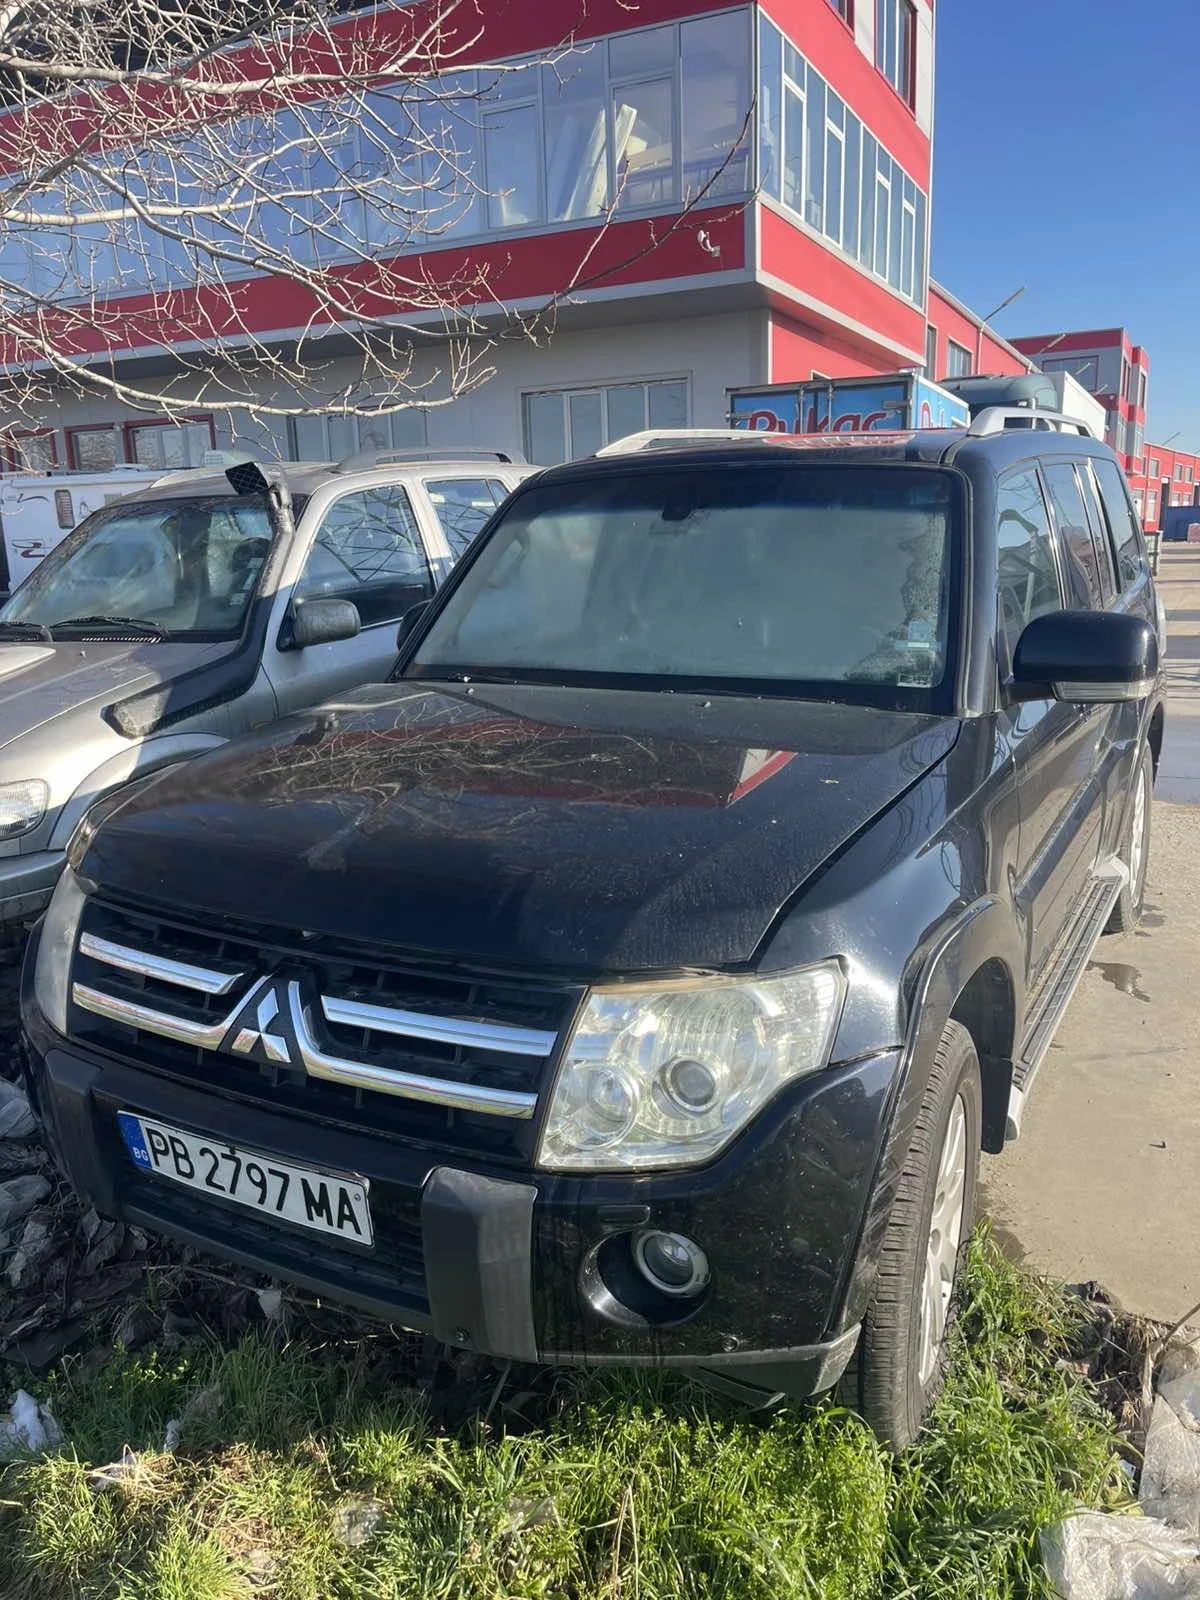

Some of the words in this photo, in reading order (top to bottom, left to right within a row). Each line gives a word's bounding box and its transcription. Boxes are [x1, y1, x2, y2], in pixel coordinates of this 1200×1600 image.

[145, 1127, 195, 1179] PB
[199, 1147, 290, 1211] 2797
[301, 1177, 362, 1236] MA
